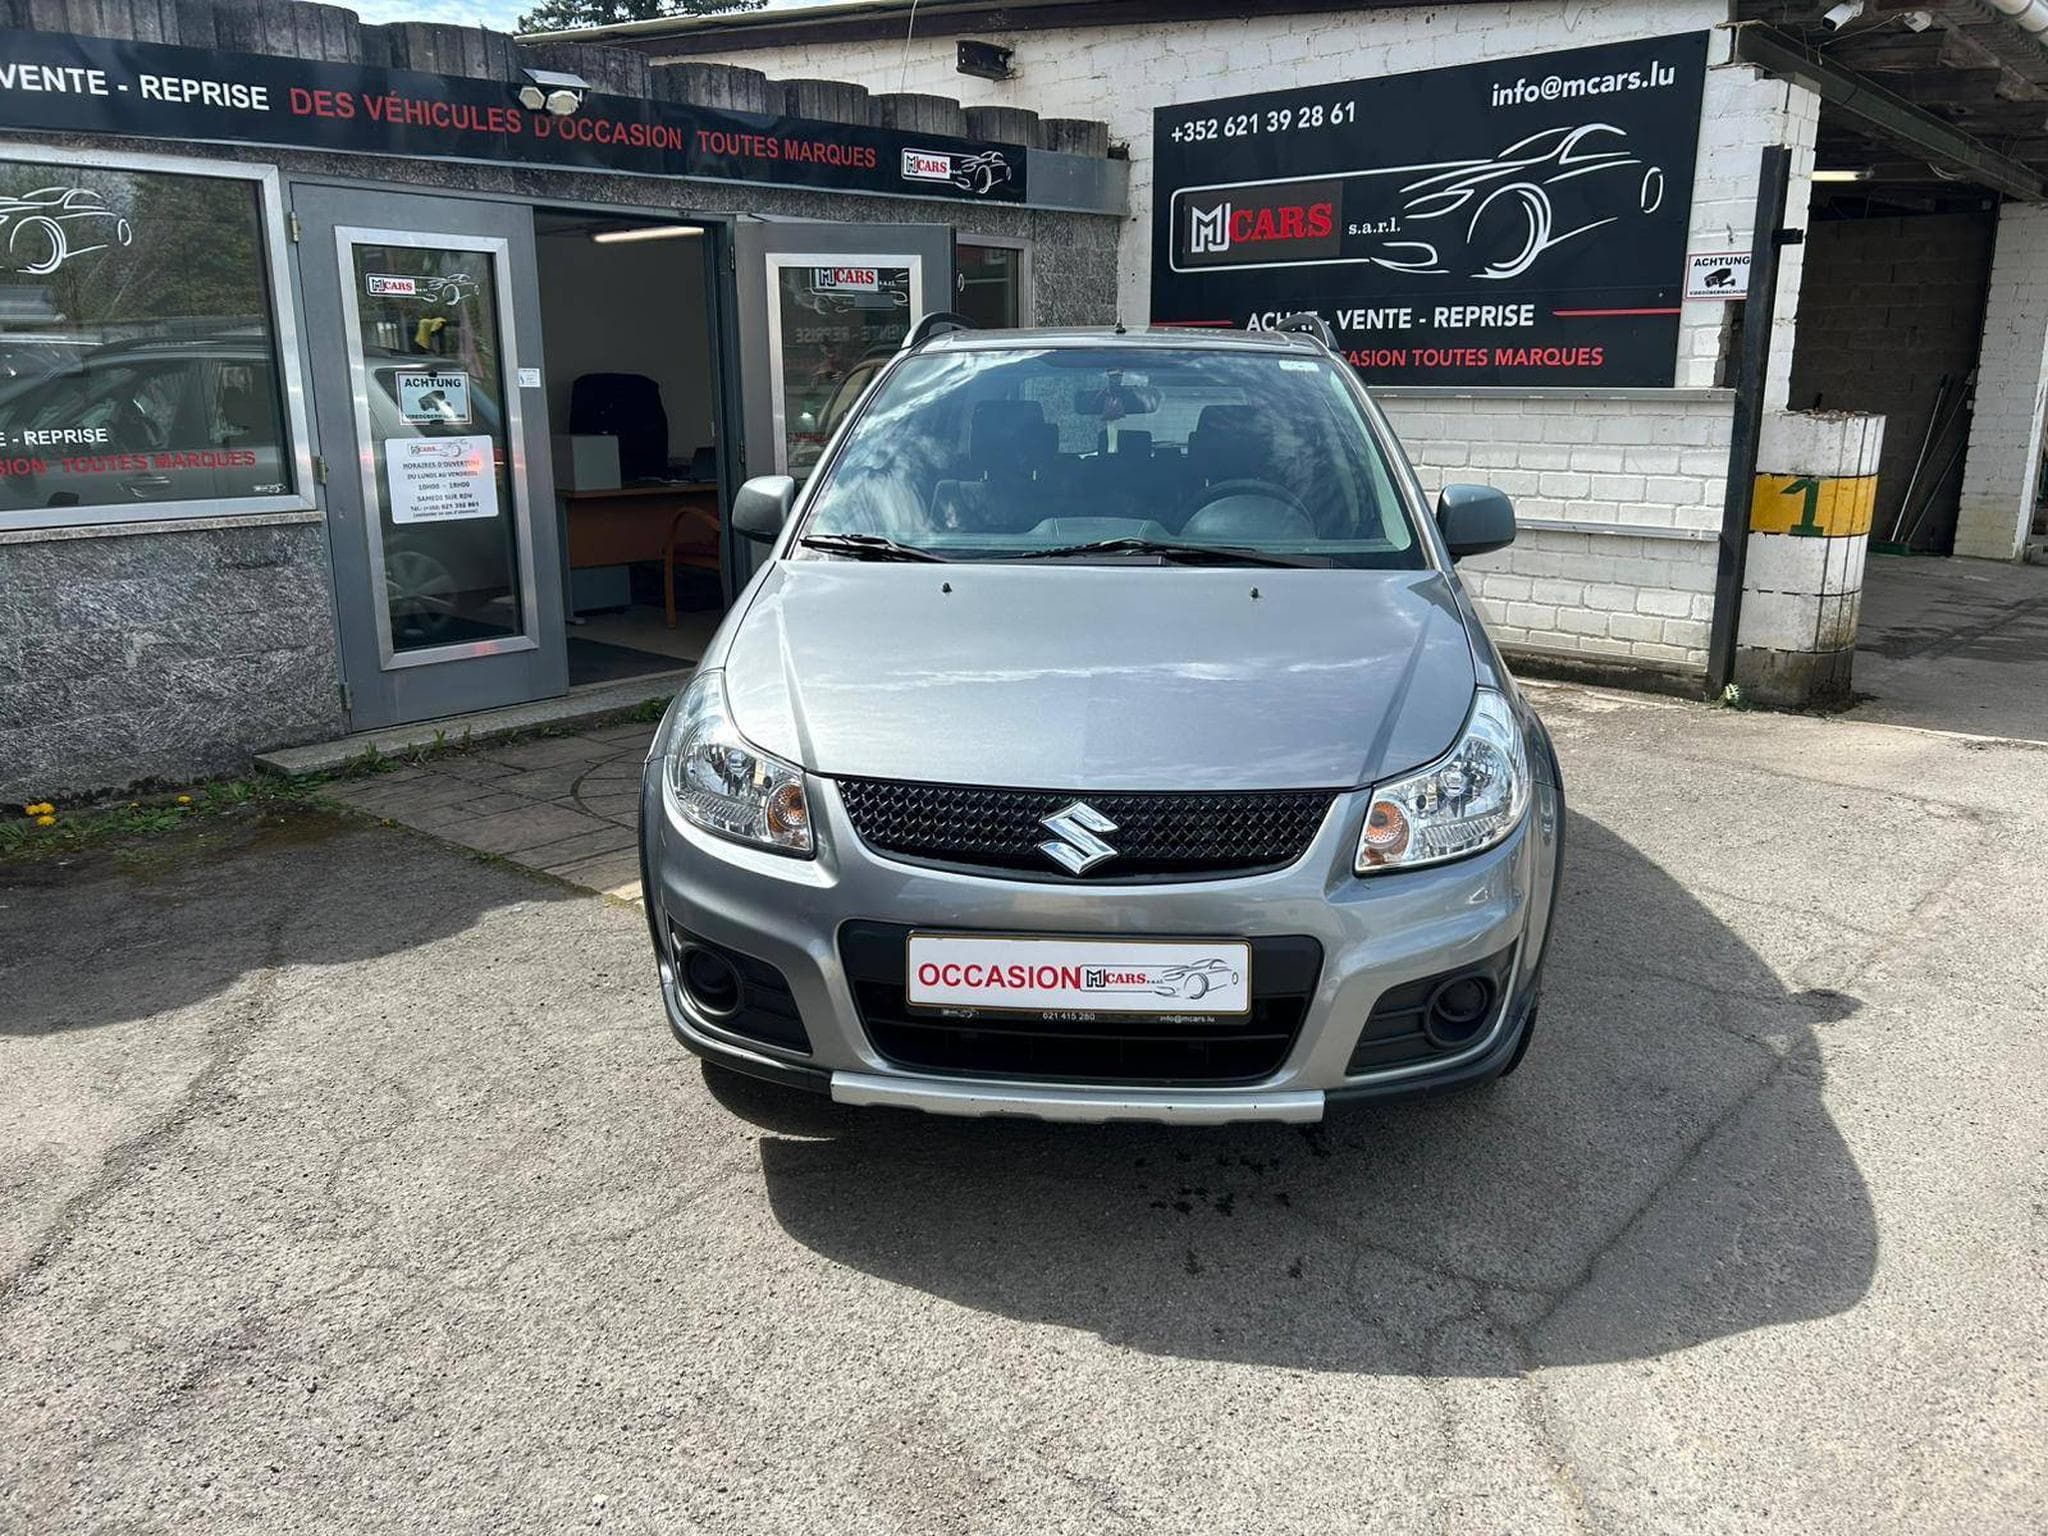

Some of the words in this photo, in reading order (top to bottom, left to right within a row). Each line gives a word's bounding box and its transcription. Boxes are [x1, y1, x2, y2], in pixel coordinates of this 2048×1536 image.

[1492, 61, 1675, 107] info@mcars.lu
[0, 64, 109, 96] VENTE
[139, 74, 270, 111] REPRISE
[290, 88, 355, 118] DES
[363, 90, 522, 134] VÉHICULES
[697, 130, 779, 158] TOUTES
[784, 139, 877, 169] MARQUES
[1172, 119, 1218, 144] +352
[1224, 115, 1259, 137] 621
[1266, 110, 1292, 133] 39
[1299, 106, 1323, 129] 28
[1330, 101, 1356, 124] 61
[1348, 217, 1401, 235] s.a.r.l.
[1693, 256, 1750, 267] ACHTUNG
[1336, 308, 1412, 330] VENTE
[1433, 304, 1535, 329] REPRISE
[1412, 348, 1488, 367] TOUTES
[1495, 347, 1604, 368] MARQUES
[404, 378, 462, 388] ACHTUNG
[23, 428, 108, 446] REPRISE
[61, 455, 149, 474] TOUTES
[155, 451, 257, 470] MARQUES
[1780, 479, 1824, 537] 1
[918, 963, 1081, 990] OCCASION
